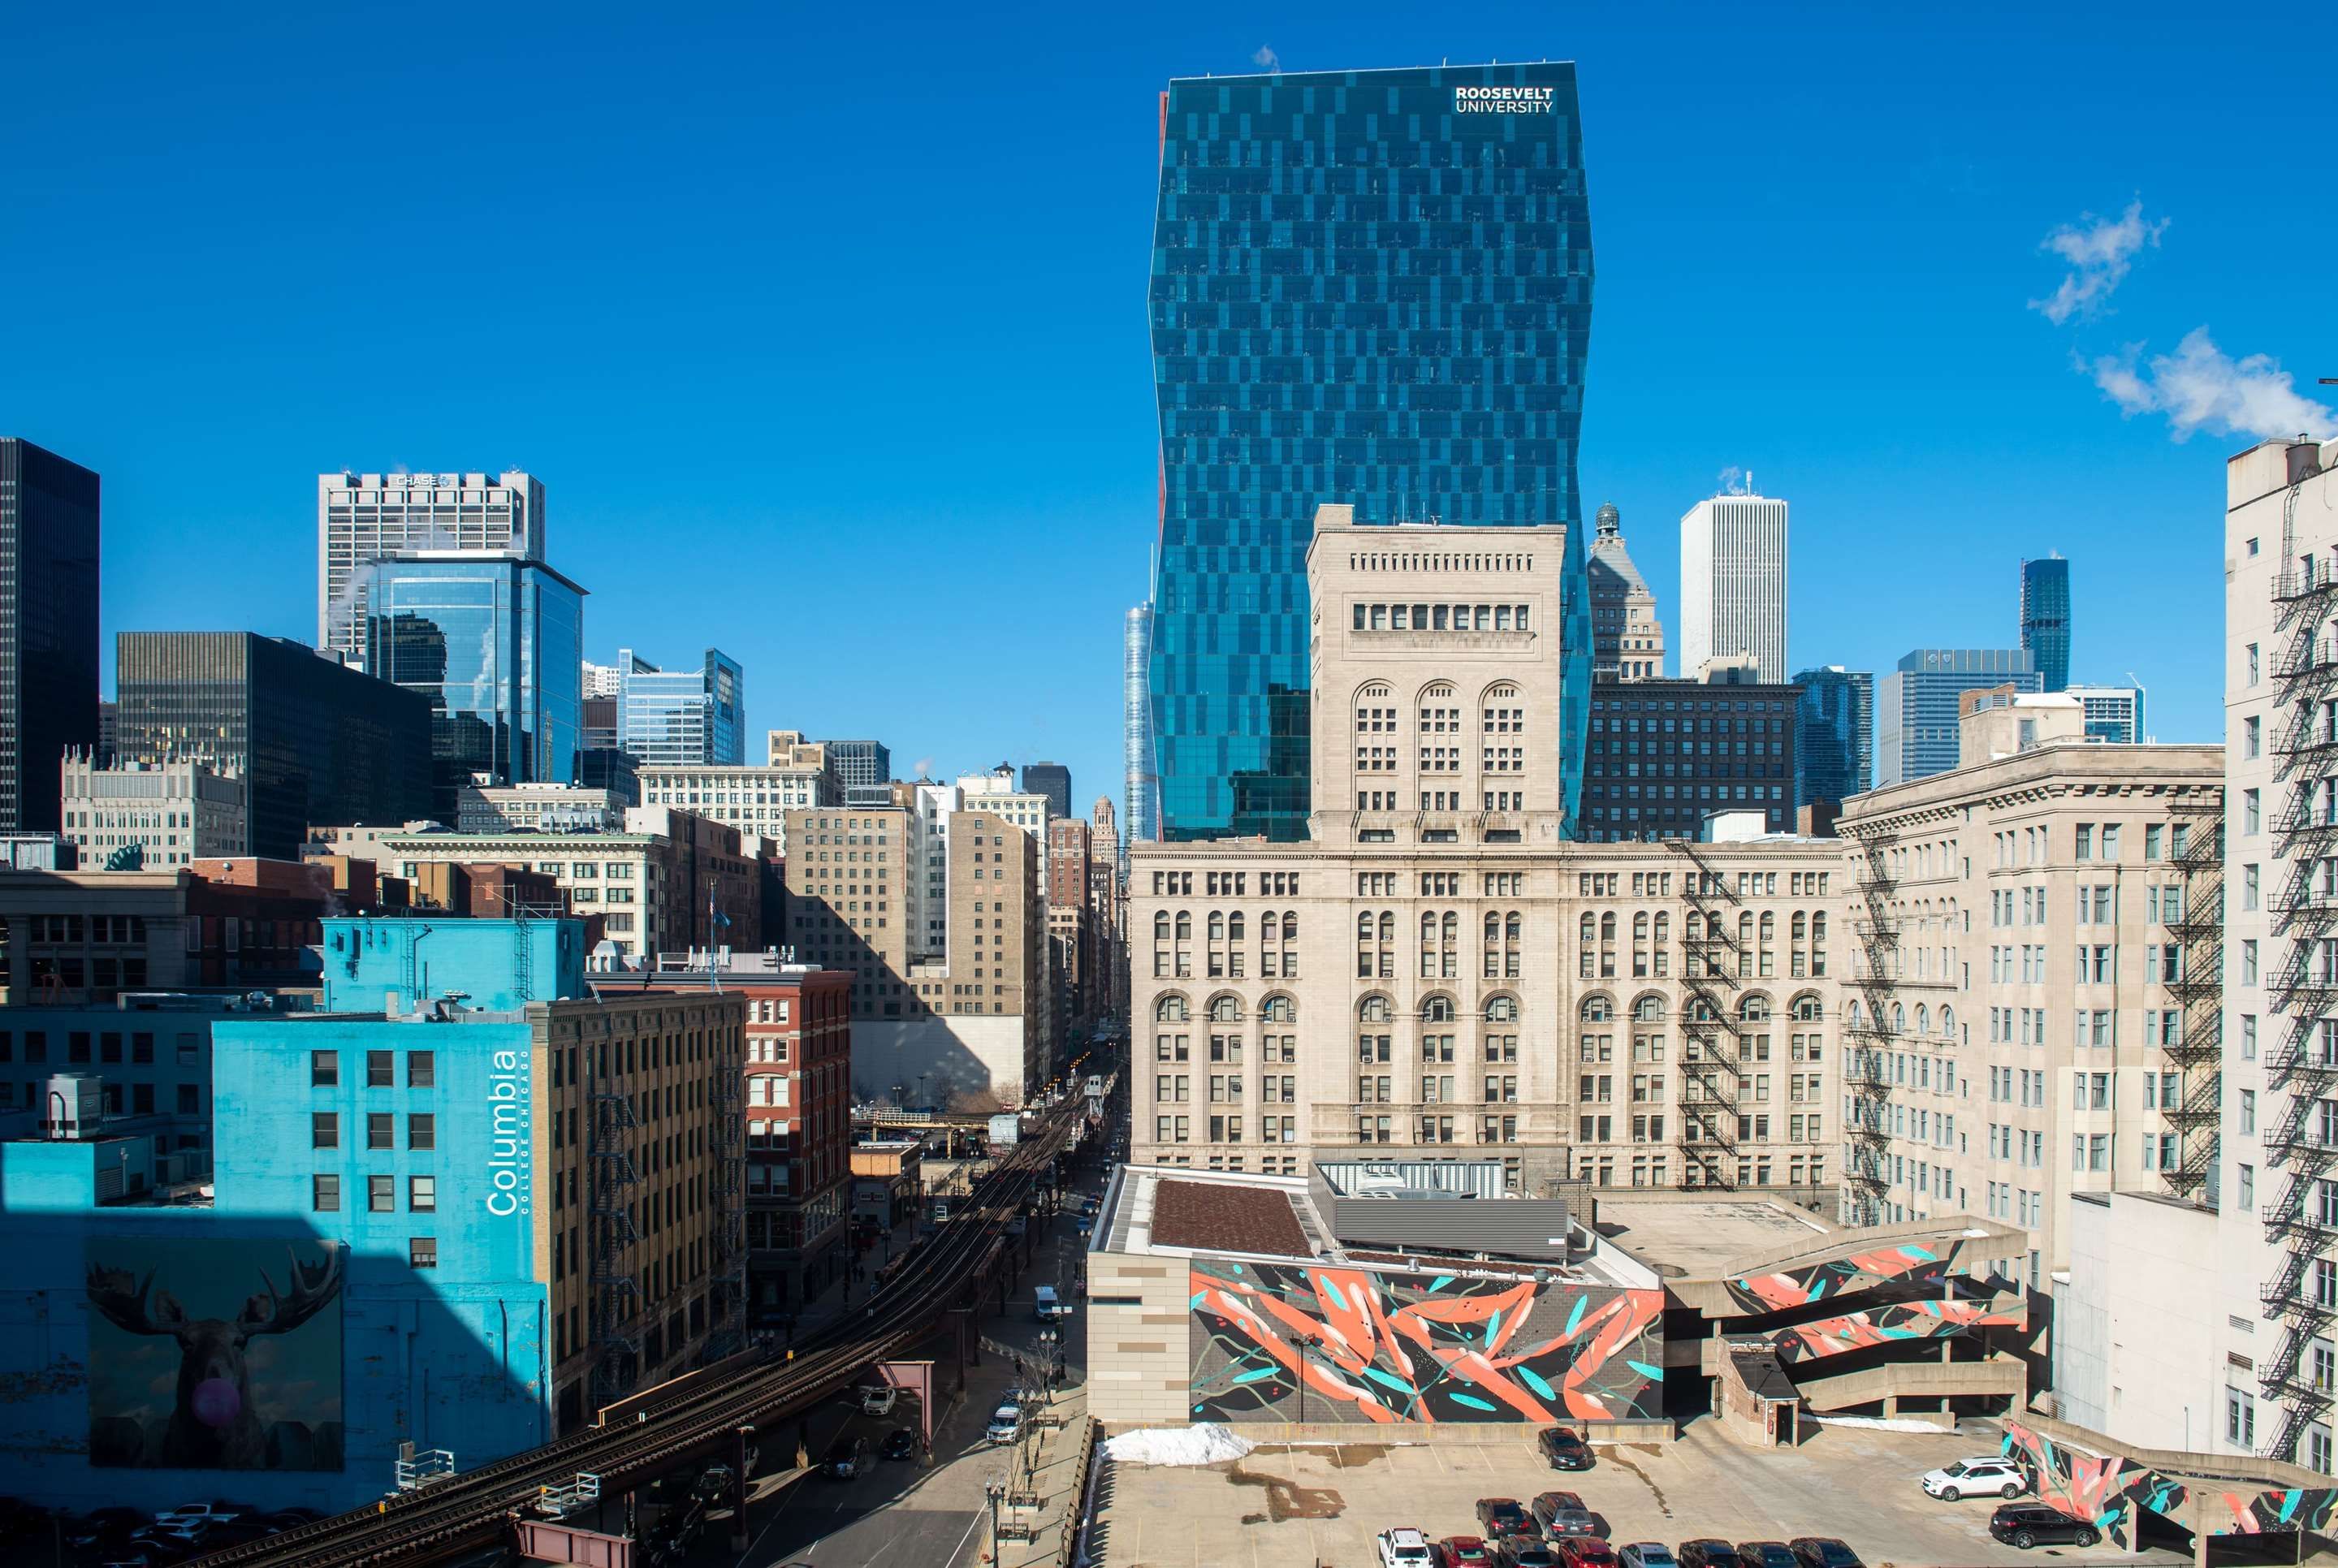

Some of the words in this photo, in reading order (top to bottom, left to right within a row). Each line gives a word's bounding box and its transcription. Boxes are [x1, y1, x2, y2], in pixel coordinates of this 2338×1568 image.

[1456, 87, 1554, 100] ROOSEVELT
[1456, 101, 1553, 114] UNIVERSITY
[396, 477, 437, 486] CHASE
[521, 1051, 529, 1128] CHICAGO
[487, 1051, 517, 1216] Columbia
[521, 1138, 529, 1215] COLLEGE
